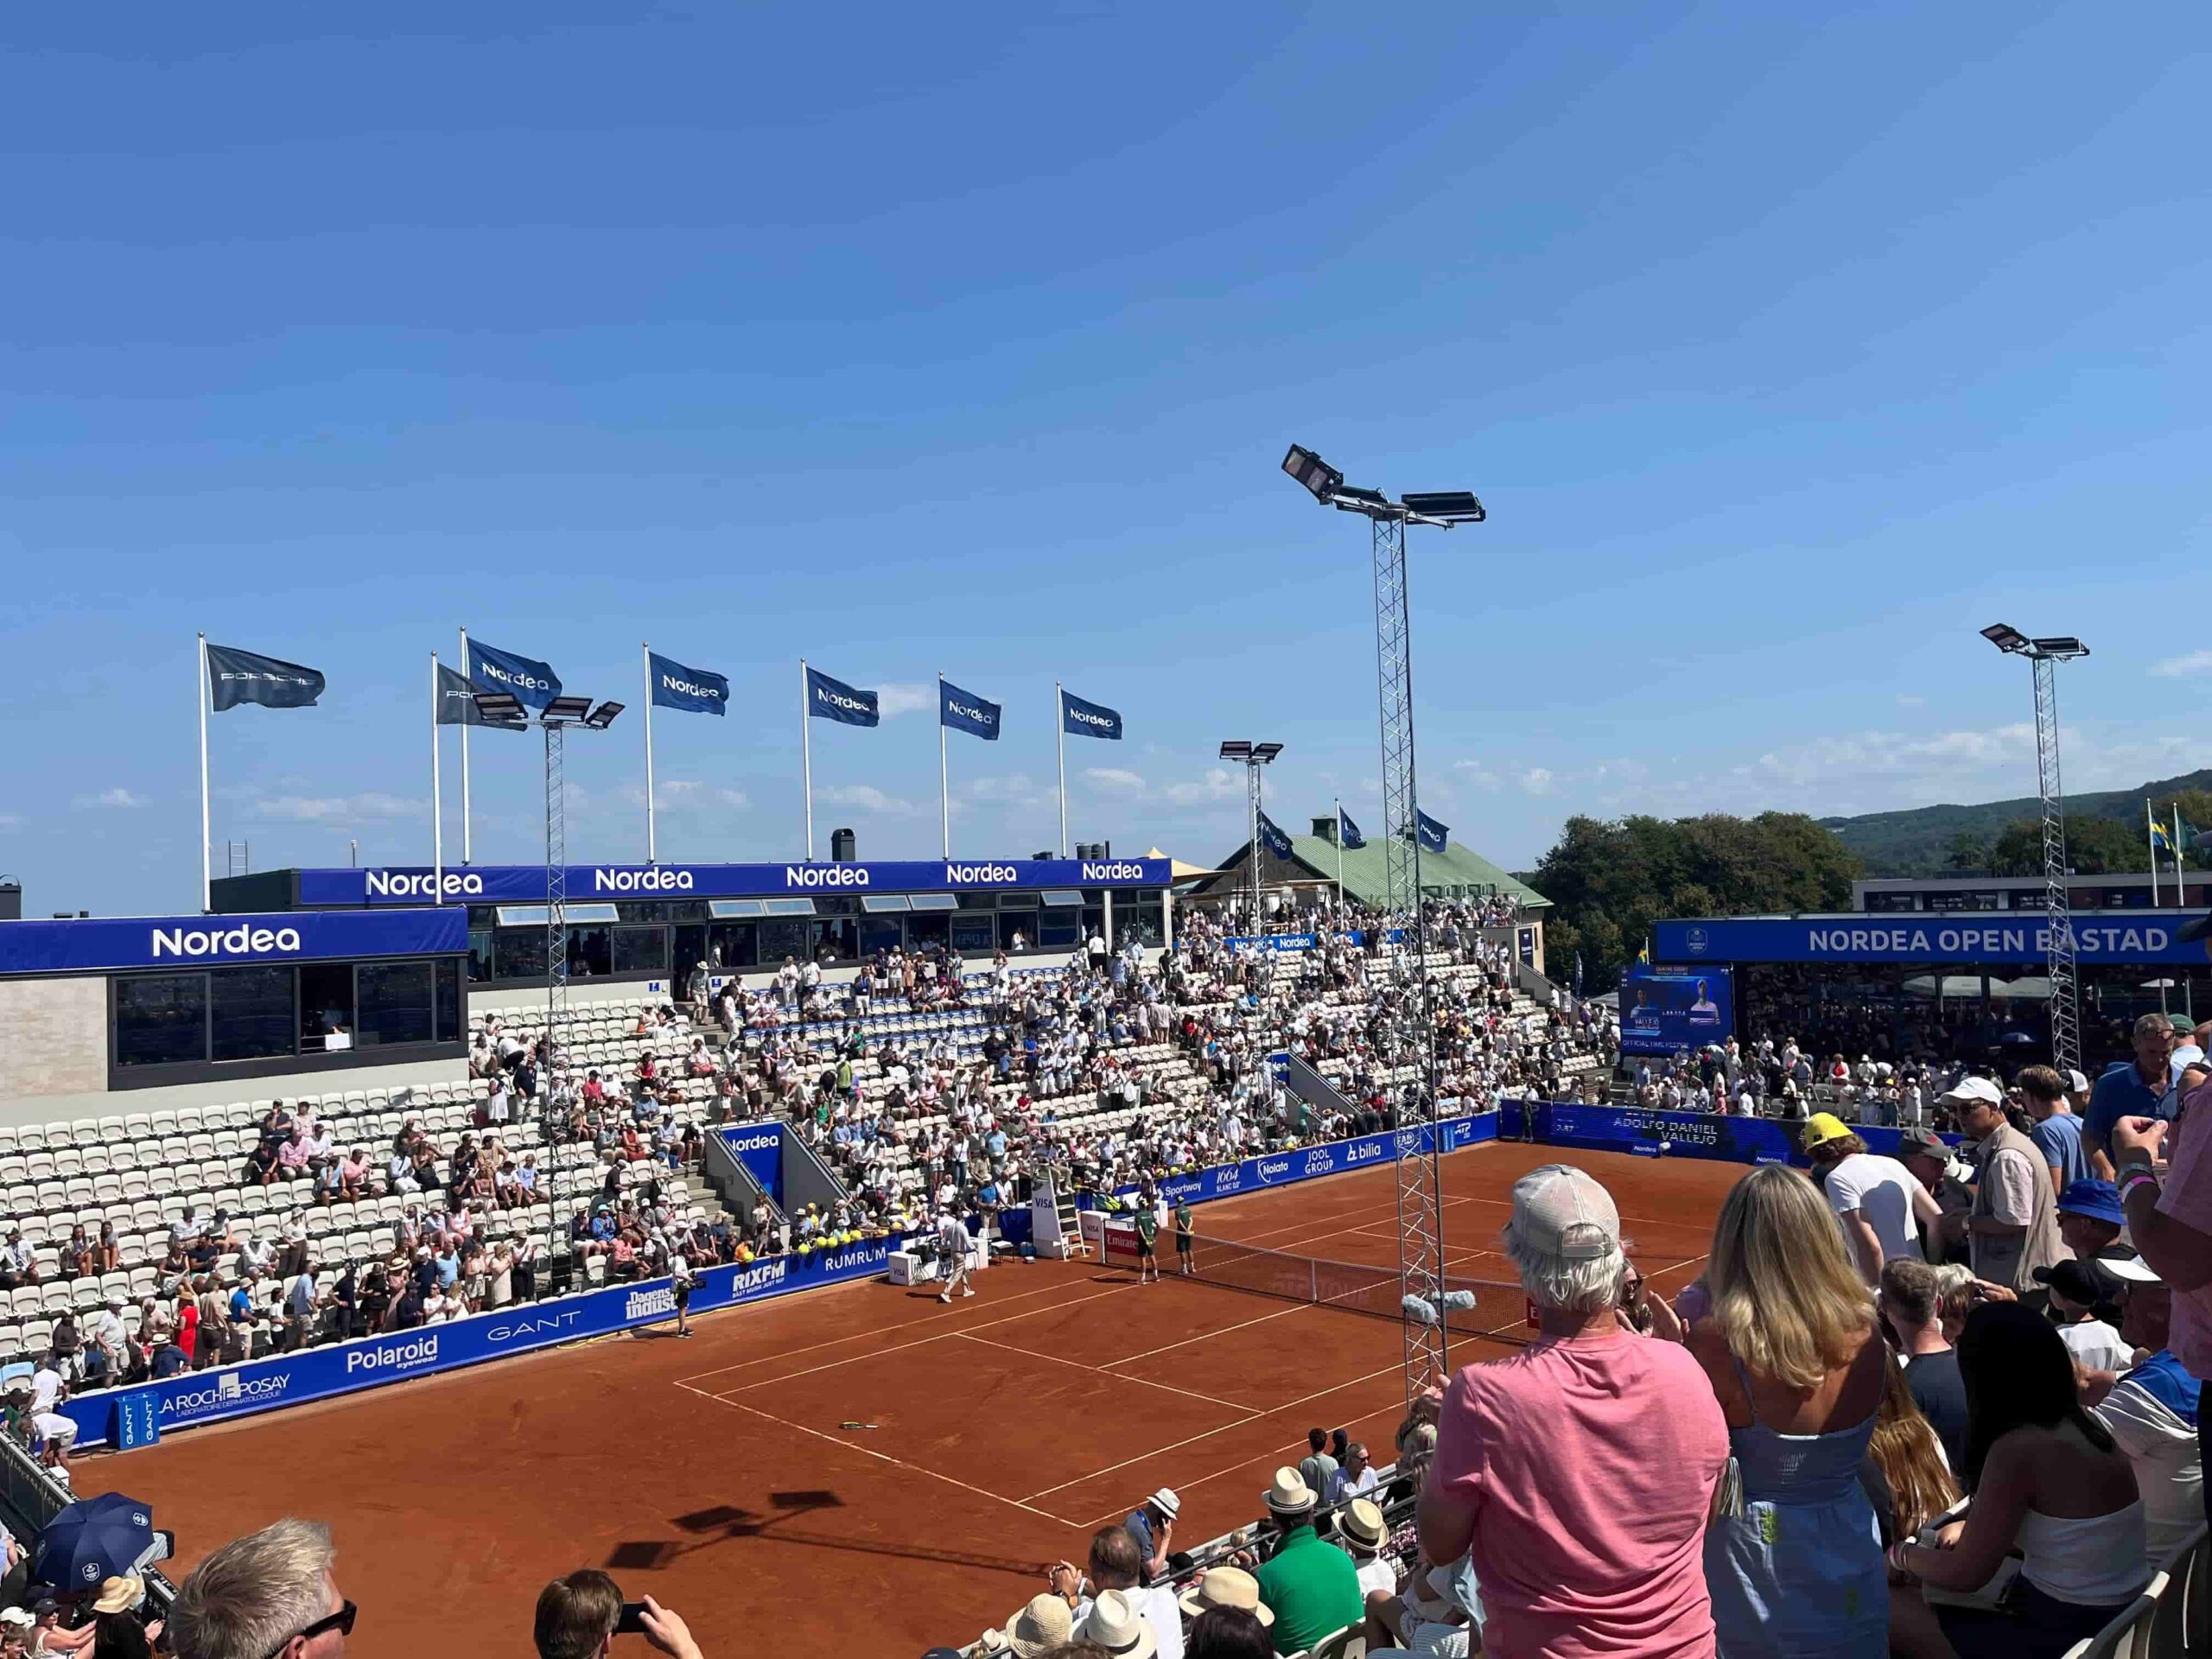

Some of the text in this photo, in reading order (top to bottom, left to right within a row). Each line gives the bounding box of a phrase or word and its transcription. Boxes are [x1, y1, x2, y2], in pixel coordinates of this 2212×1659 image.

[221, 672, 316, 686] PORSCHE
[481, 662, 549, 690] Nordea
[663, 675, 719, 697] Nordea
[817, 688, 870, 711] Nordea
[949, 700, 992, 725] Nordea
[1070, 709, 1114, 728] Nordea
[595, 867, 693, 891] Nordea
[787, 864, 868, 887] Nordea
[947, 862, 1017, 883] Nordea
[1083, 861, 1142, 880] Nordea
[153, 924, 301, 957] Nordea
[1280, 937, 1310, 949] Nordea
[1809, 930, 1931, 951] NORDEA
[1938, 929, 2024, 951] OPEN
[1661, 1131, 1717, 1145] VALLEJO
[1669, 1122, 1718, 1135] DANIEL
[1308, 1148, 1330, 1161] JOOL
[1359, 1143, 1382, 1159] bilia
[1263, 1161, 1289, 1175] Nolato
[1305, 1160, 1334, 1174] GROUP
[1166, 1181, 1202, 1198] Sportway
[1035, 1198, 1053, 1210] VISA
[825, 1247, 887, 1271] RUMRUM
[893, 1267, 906, 1276] VISA
[629, 1287, 671, 1306] Dagens
[487, 1311, 582, 1341] GANT
[347, 1334, 438, 1373] Polaroid
[396, 1354, 438, 1370] eyewear
[176, 1389, 282, 1417] LABORATOIRE DERMATOLOGIQUE
